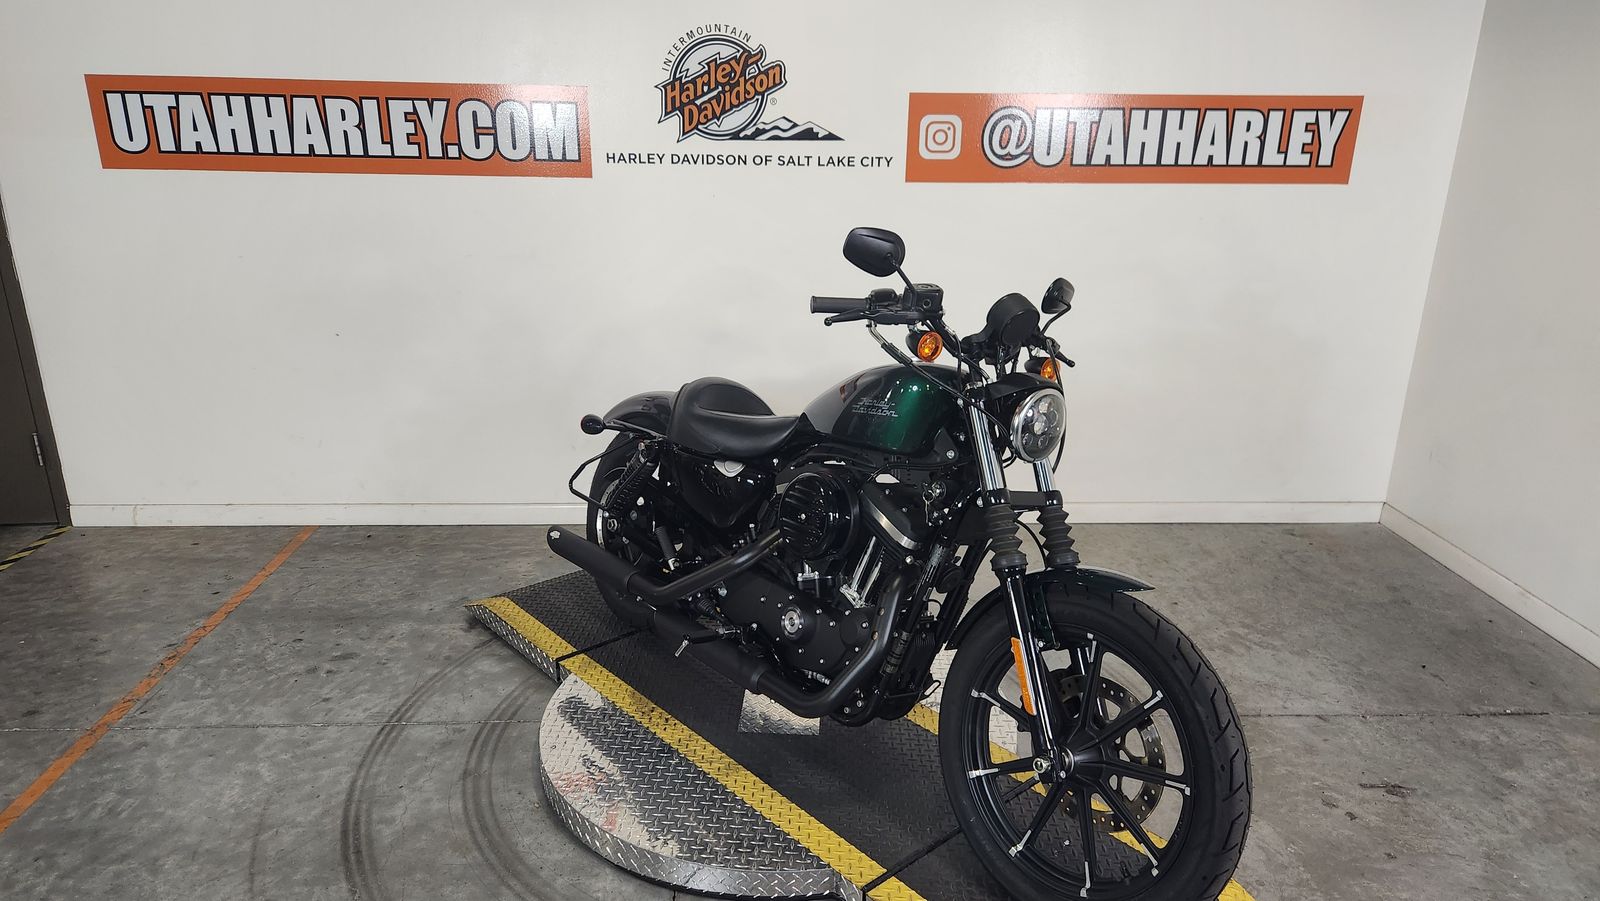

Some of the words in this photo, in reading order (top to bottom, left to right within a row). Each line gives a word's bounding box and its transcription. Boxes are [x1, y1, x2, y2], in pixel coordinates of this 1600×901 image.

[661, 23, 752, 71] INTERMOUNTAIN
[103, 90, 582, 162] UTAHHARLEY.COM
[682, 64, 783, 134] Davidson
[606, 153, 666, 164] HARLEY
[671, 153, 748, 166] DAVIDSON
[753, 155, 773, 166] OF
[778, 155, 813, 167] SALT
[817, 156, 855, 167] LAKE
[860, 156, 893, 168] CITY
[981, 105, 1352, 168] @UTAHHARLEY
